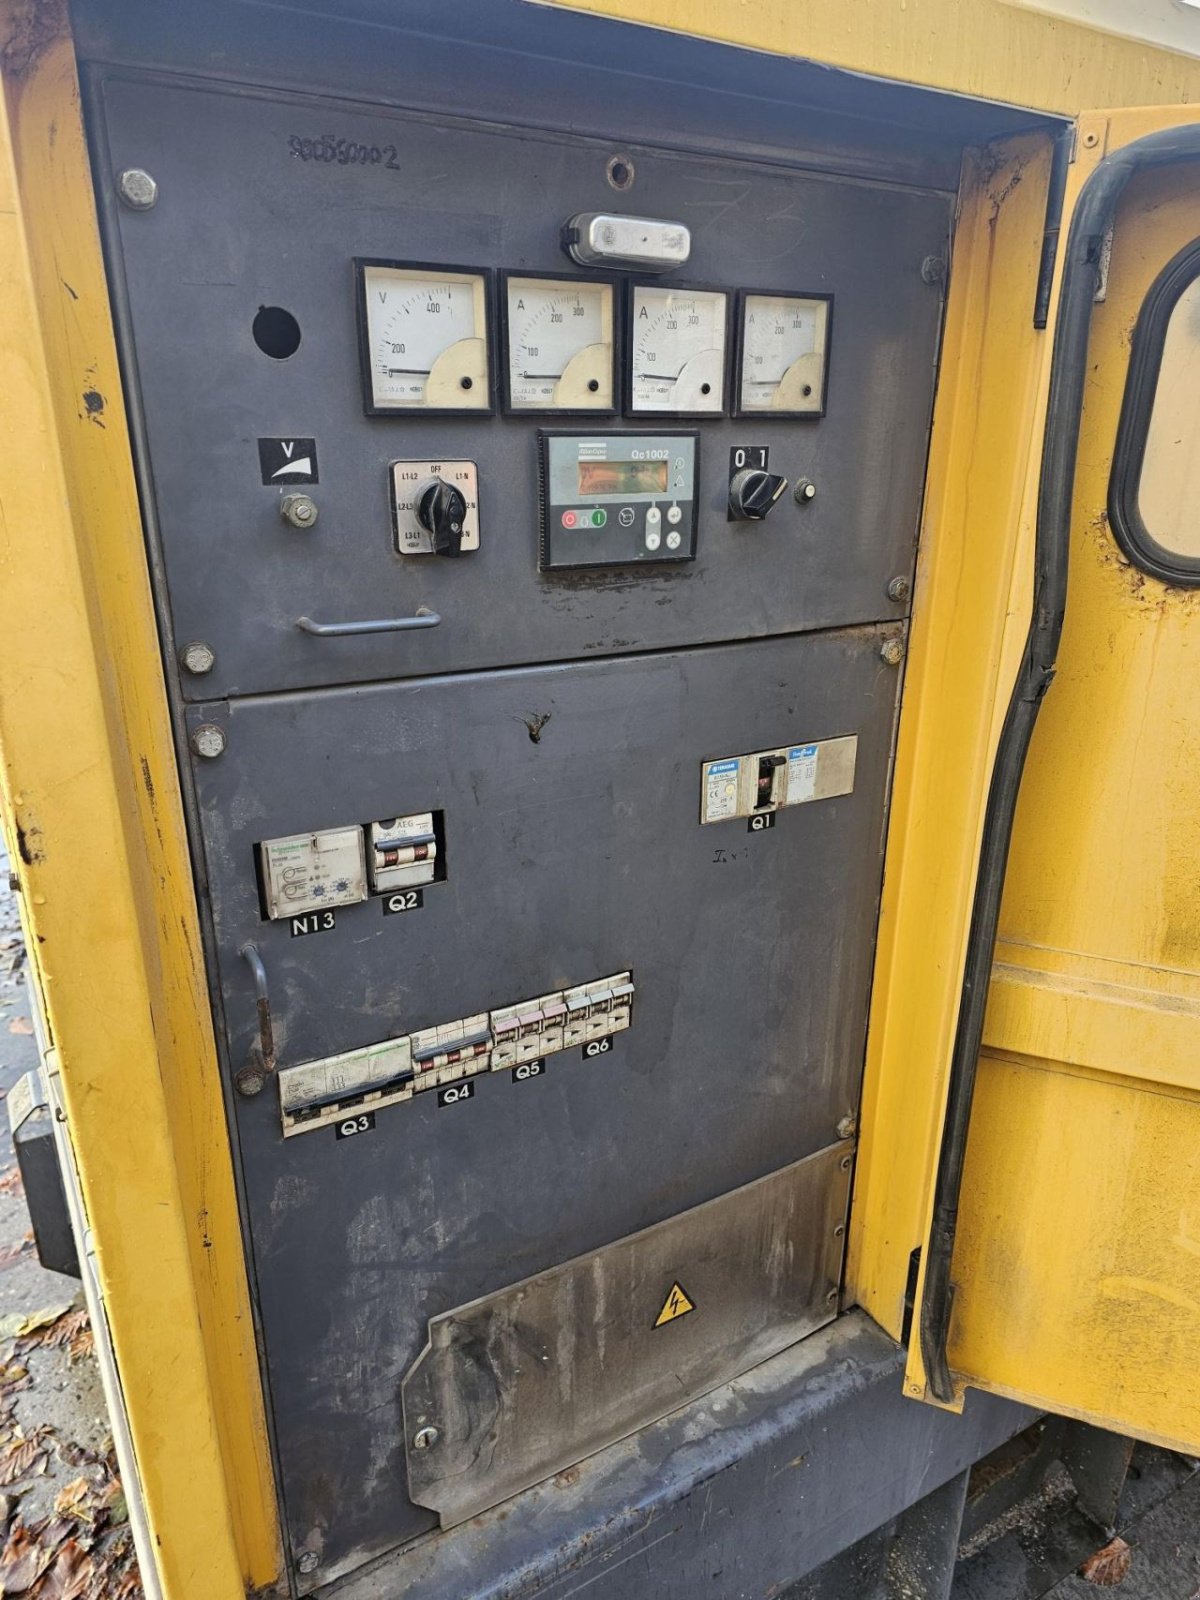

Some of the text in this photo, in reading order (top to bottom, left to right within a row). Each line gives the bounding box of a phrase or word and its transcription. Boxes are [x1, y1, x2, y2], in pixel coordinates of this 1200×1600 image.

[378, 291, 388, 304] V
[426, 302, 441, 314] 400
[516, 299, 526, 311] A
[550, 312, 563, 323] 200
[573, 306, 585, 317] 300
[638, 305, 649, 320] A
[666, 320, 678, 330] 200
[774, 325, 785, 335] 200
[390, 343, 406, 354] 200
[527, 346, 539, 357] 100
[281, 442, 294, 458] V
[631, 449, 669, 460] Qc1002
[735, 449, 767, 468] 0 1
[430, 465, 441, 474] OFF
[402, 473, 418, 481] L1-L2
[456, 472, 469, 481] L1-N
[405, 532, 420, 540] L3-L1
[397, 819, 414, 829] AEG
[752, 814, 771, 831] Q1
[388, 891, 418, 912] Q2
[293, 912, 335, 936] N13
[586, 1040, 610, 1057] Q6
[516, 1063, 540, 1080] Q5
[443, 1084, 470, 1104] Q4
[340, 1116, 370, 1137] Q3
